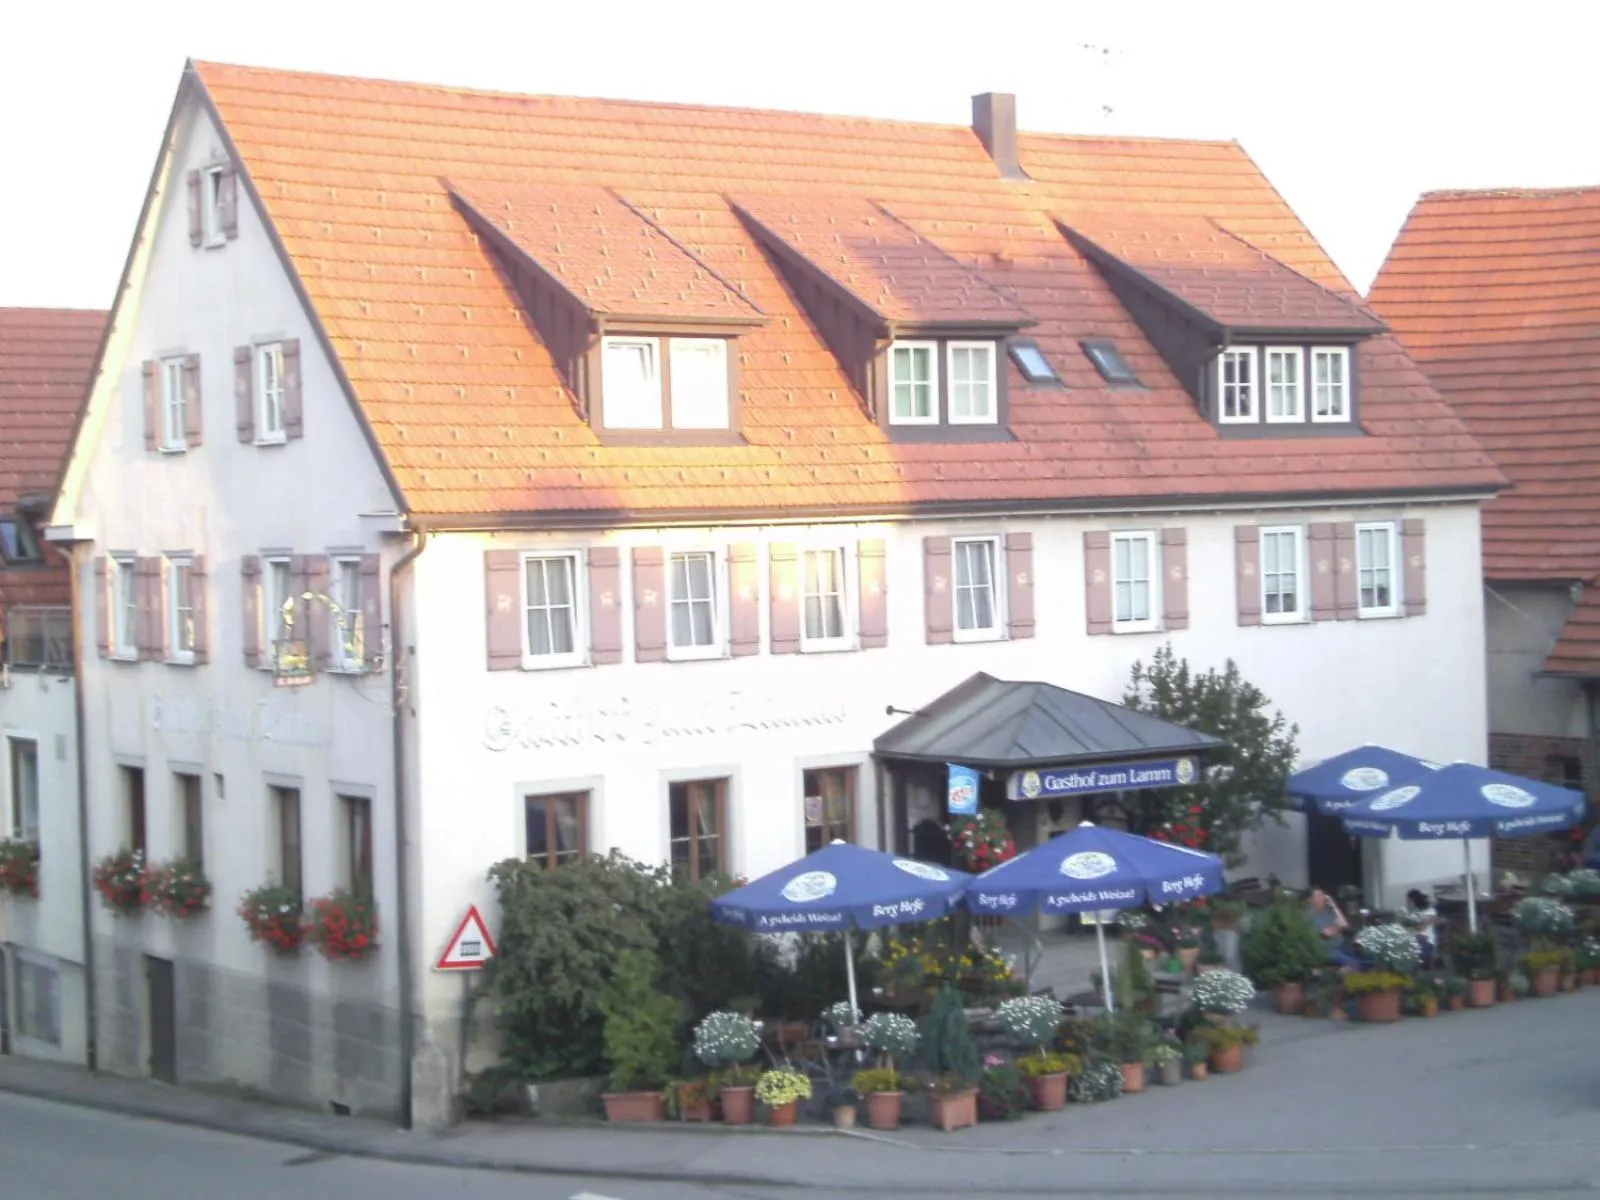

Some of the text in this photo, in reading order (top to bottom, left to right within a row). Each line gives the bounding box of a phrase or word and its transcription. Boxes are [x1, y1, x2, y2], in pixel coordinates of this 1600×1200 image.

[1044, 768, 1172, 790] Gasthof zum Lamm
[1418, 821, 1471, 836] Berg Hefe
[1162, 879, 1184, 895] Berg
[873, 898, 925, 918] Berg Hefe
